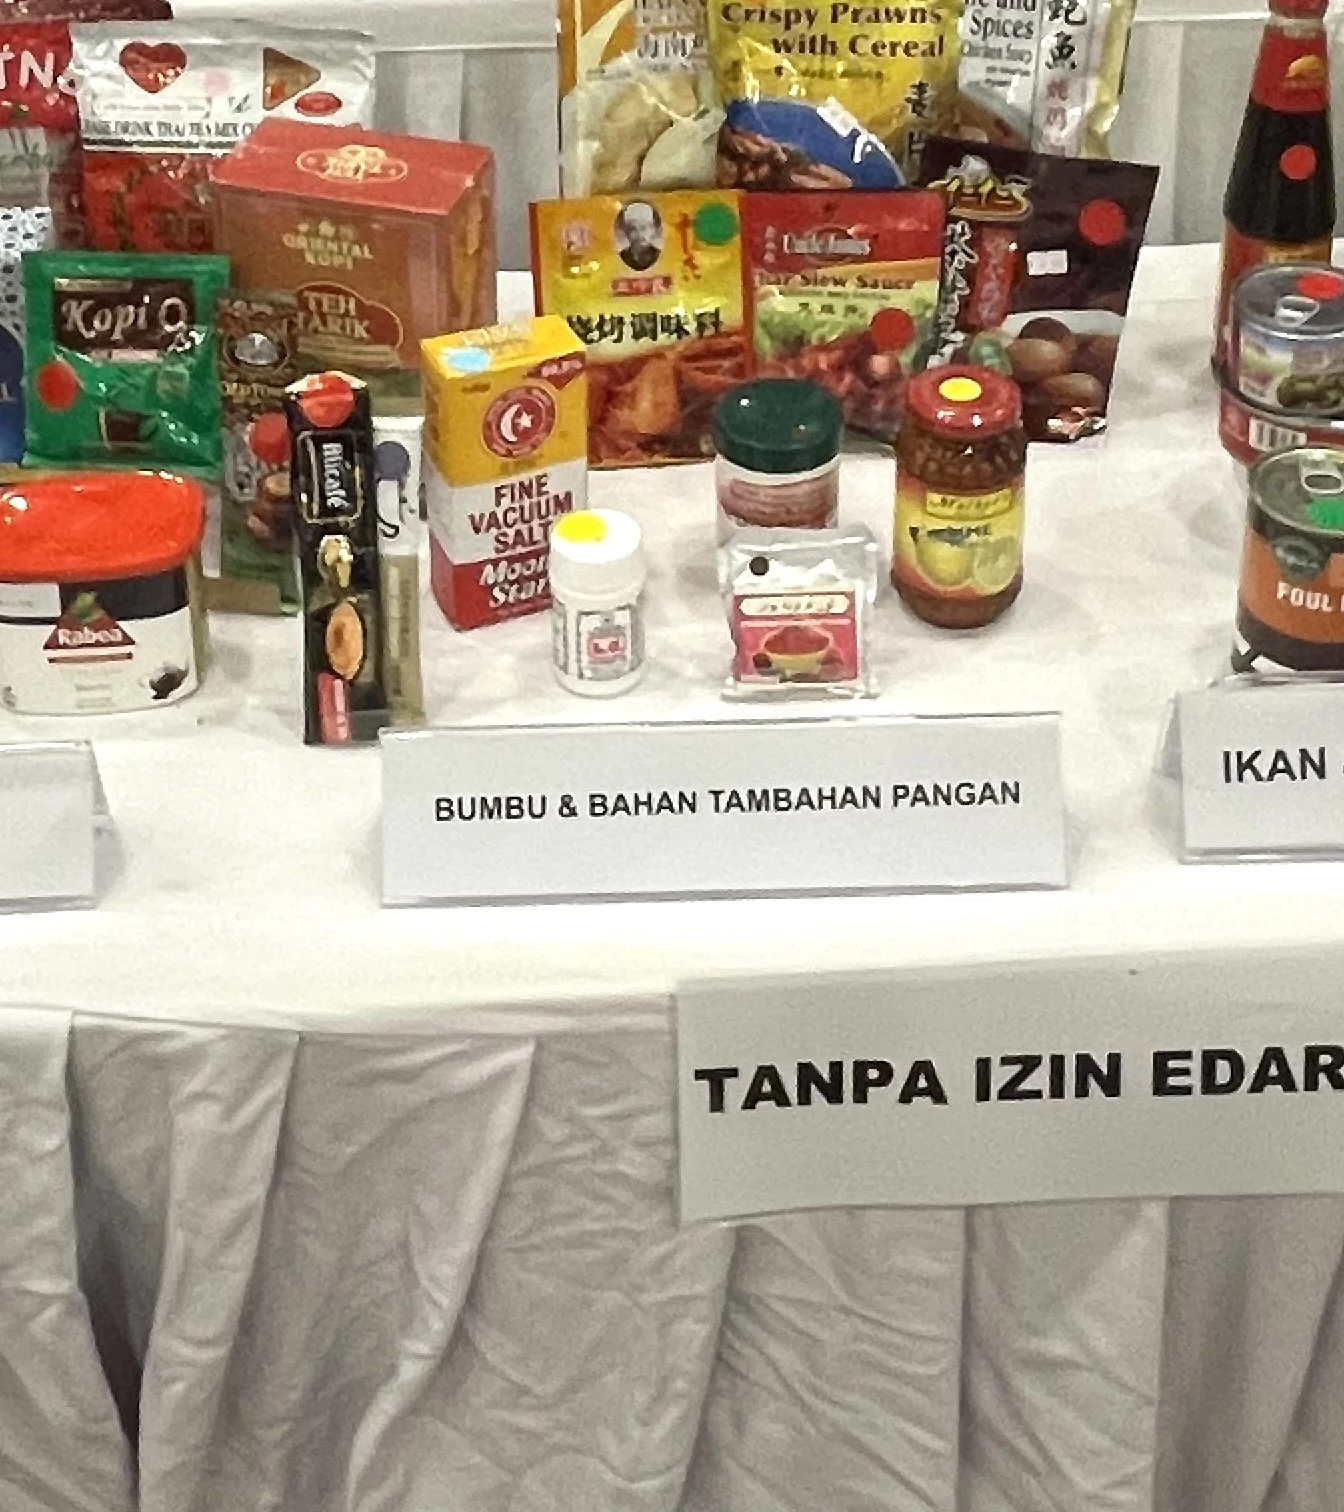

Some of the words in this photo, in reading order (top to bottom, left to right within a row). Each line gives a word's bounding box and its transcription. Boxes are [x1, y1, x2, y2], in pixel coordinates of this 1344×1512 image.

[721, 1, 817, 29] Crispy
[829, 0, 943, 26] Prawns
[968, 8, 1036, 41] Spices
[770, 34, 838, 58] with
[848, 33, 946, 58] Cereal
[60, 294, 152, 339] Kopi
[493, 472, 552, 508] FINE
[467, 490, 576, 535] VACUUM
[493, 520, 553, 555] SALT
[1276, 580, 1333, 614] FOUL
[1221, 746, 1328, 784] IKAN
[433, 794, 549, 823] BUMBU
[557, 793, 579, 818] &
[588, 789, 698, 818] BAHAN
[707, 782, 881, 814] TAMBAHAN
[891, 779, 1022, 809] PANGAN
[694, 1057, 950, 1115] TANPA
[973, 1051, 1124, 1103] IZIN
